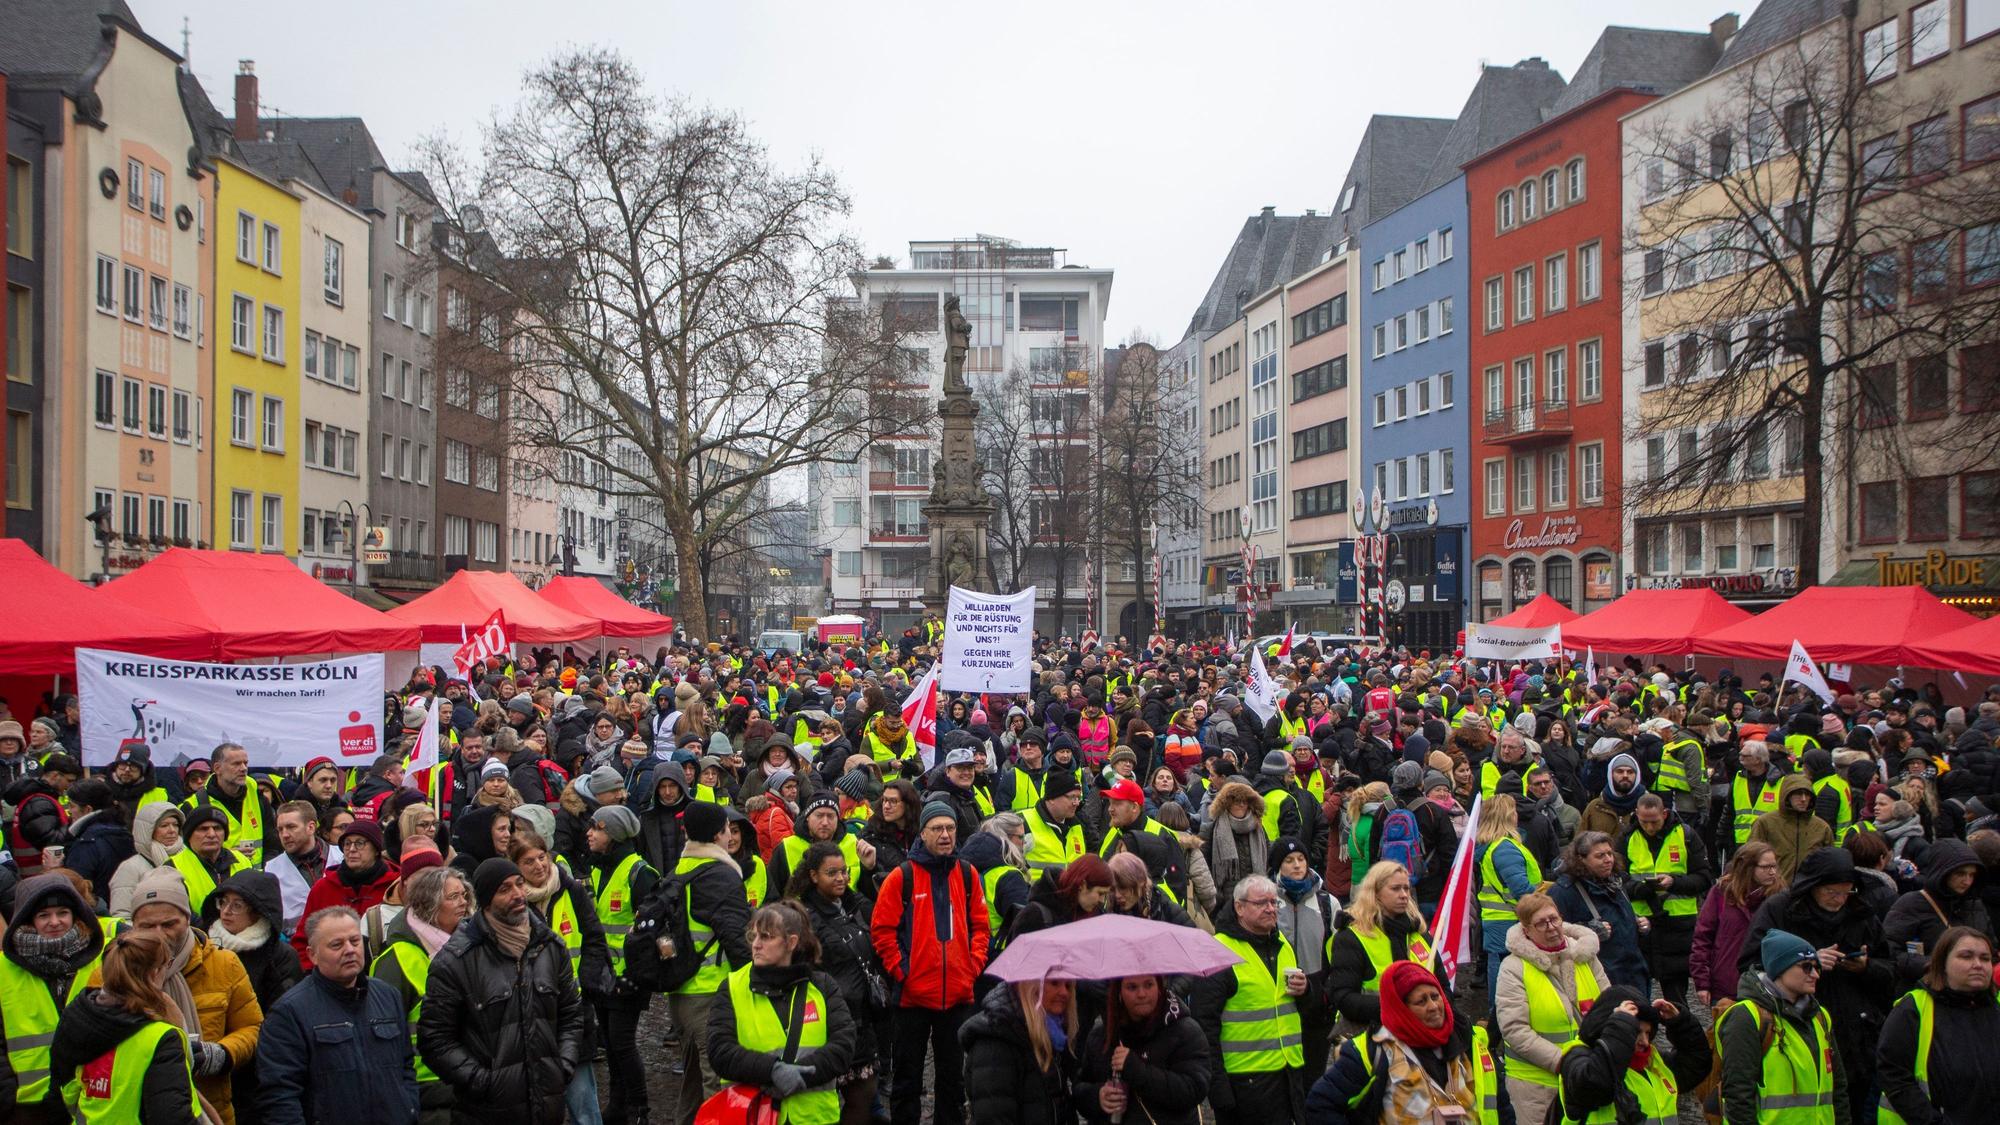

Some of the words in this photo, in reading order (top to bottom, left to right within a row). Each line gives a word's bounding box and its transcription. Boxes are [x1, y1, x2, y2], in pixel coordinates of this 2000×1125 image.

[619, 508, 628, 563] HOTEL
[1504, 516, 1577, 549] Chocolaterie
[366, 552, 388, 560] KIOSK
[1437, 561, 1456, 570] Gaffel
[1339, 568, 1356, 577] Gaffel
[1681, 576, 1726, 591] MARCO
[1727, 575, 1763, 592] POLO
[965, 604, 1011, 612] MILLIARDEN
[954, 613, 968, 621] FÜR
[970, 614, 982, 622] DIE
[984, 613, 1021, 623] RÜSTUNG
[956, 624, 972, 632] UND
[974, 625, 1002, 633] NICHTS
[1004, 624, 1018, 633] FÜR
[964, 649, 992, 657] GEGEN
[994, 650, 1011, 658] IHRE
[106, 662, 294, 680] KREISSPARKASSE
[301, 664, 358, 681] KÖLN
[236, 688, 254, 697] Wir
[257, 688, 297, 697] machen
[299, 689, 326, 698] Tarif!
